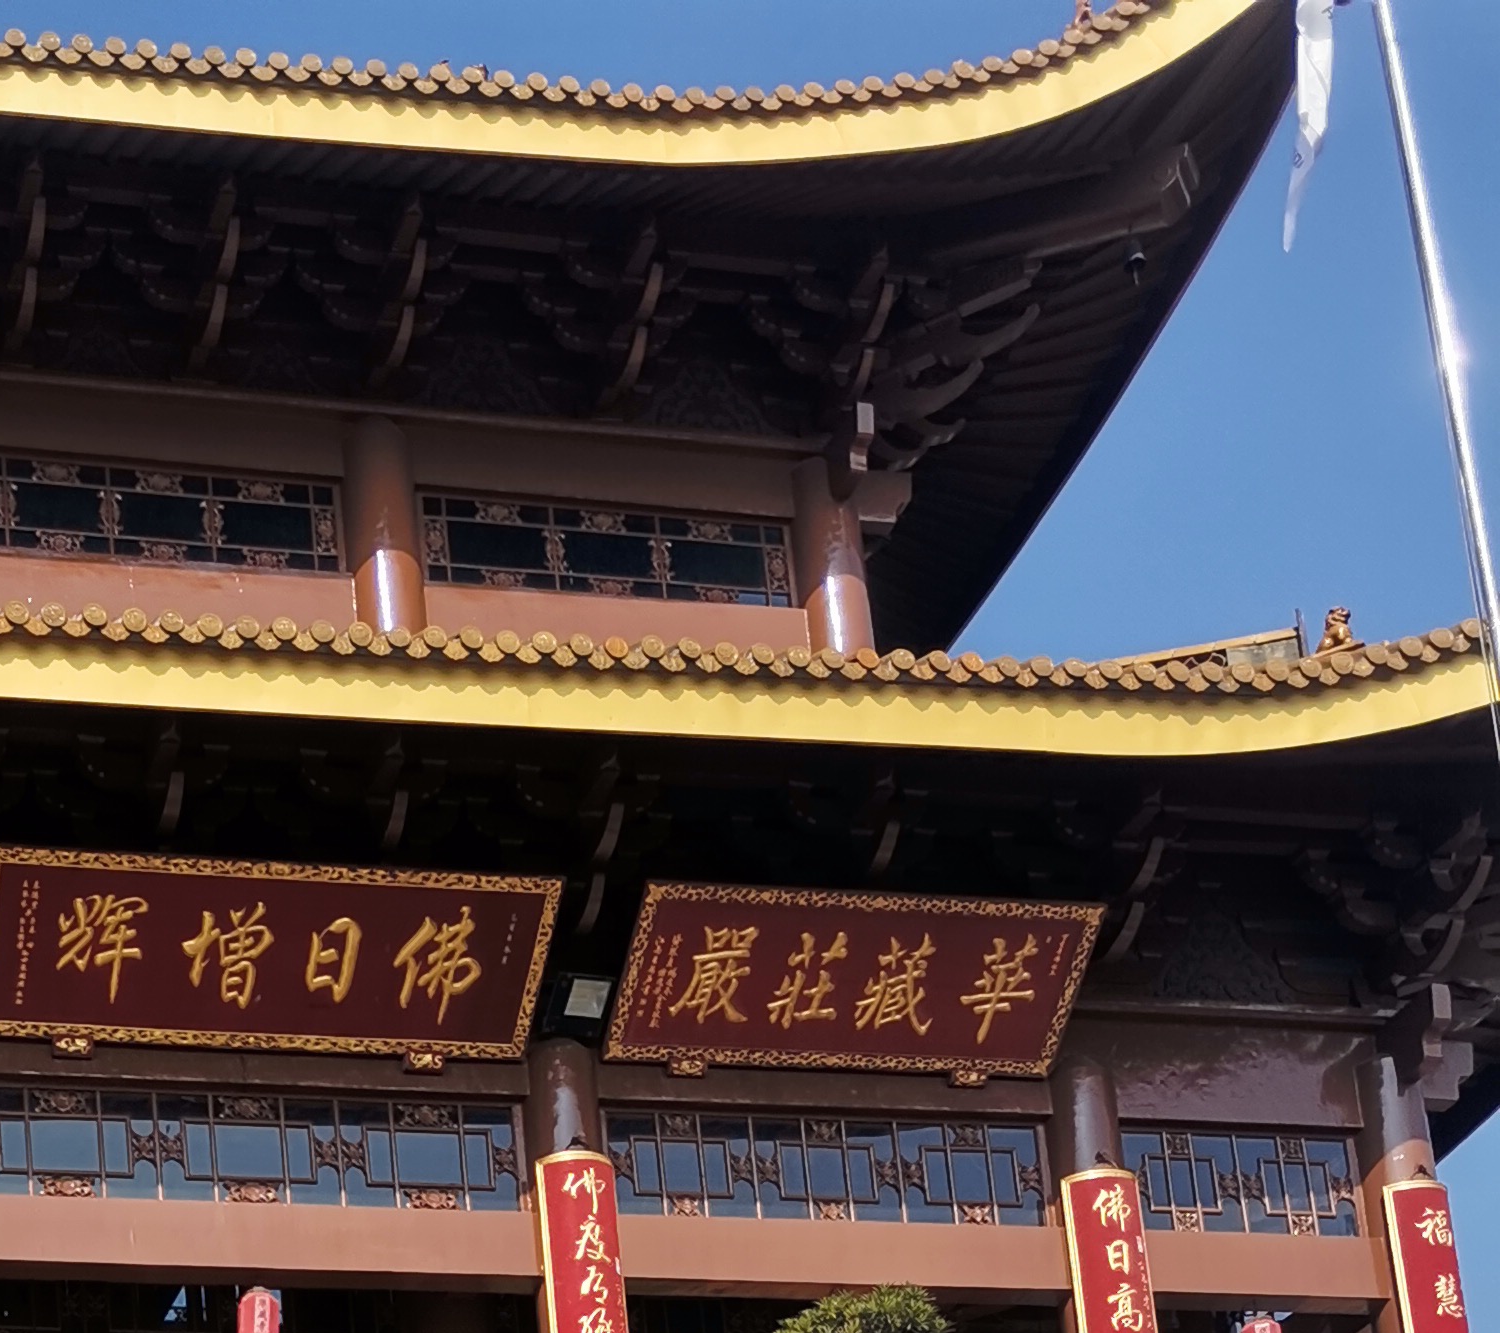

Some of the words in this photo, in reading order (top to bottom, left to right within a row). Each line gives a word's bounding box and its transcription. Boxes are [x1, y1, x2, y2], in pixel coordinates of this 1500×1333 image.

[55, 894, 483, 1026] 佛日增輝
[668, 926, 1039, 1044] 華藏莊嚴
